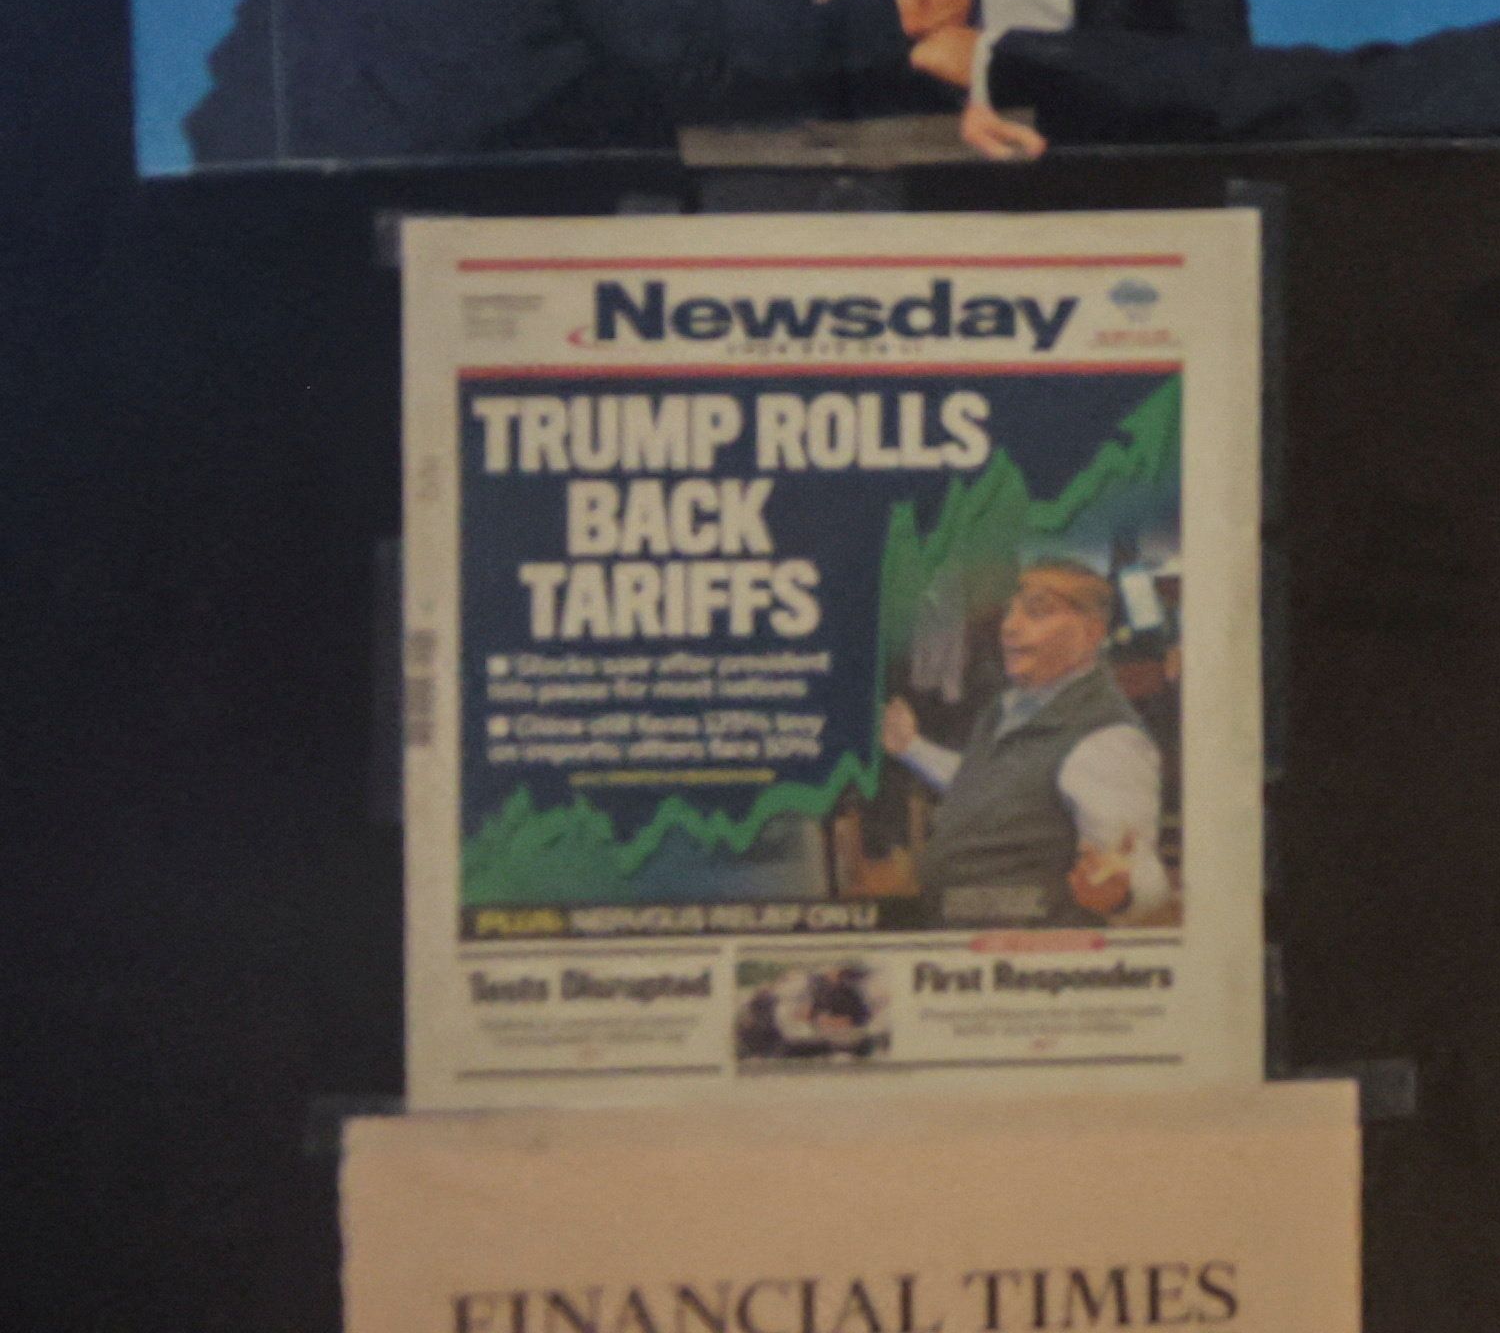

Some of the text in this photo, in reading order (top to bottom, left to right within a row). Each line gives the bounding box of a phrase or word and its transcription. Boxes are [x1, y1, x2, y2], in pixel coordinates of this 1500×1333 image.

[594, 279, 1081, 353] Newsday
[472, 390, 991, 473] TRUMP ROLLS
[565, 477, 775, 557] BACK
[517, 558, 822, 641] TARIFFS
[913, 958, 1174, 997] First Responders
[452, 1261, 1240, 1333] FINANCIAL TIMES
